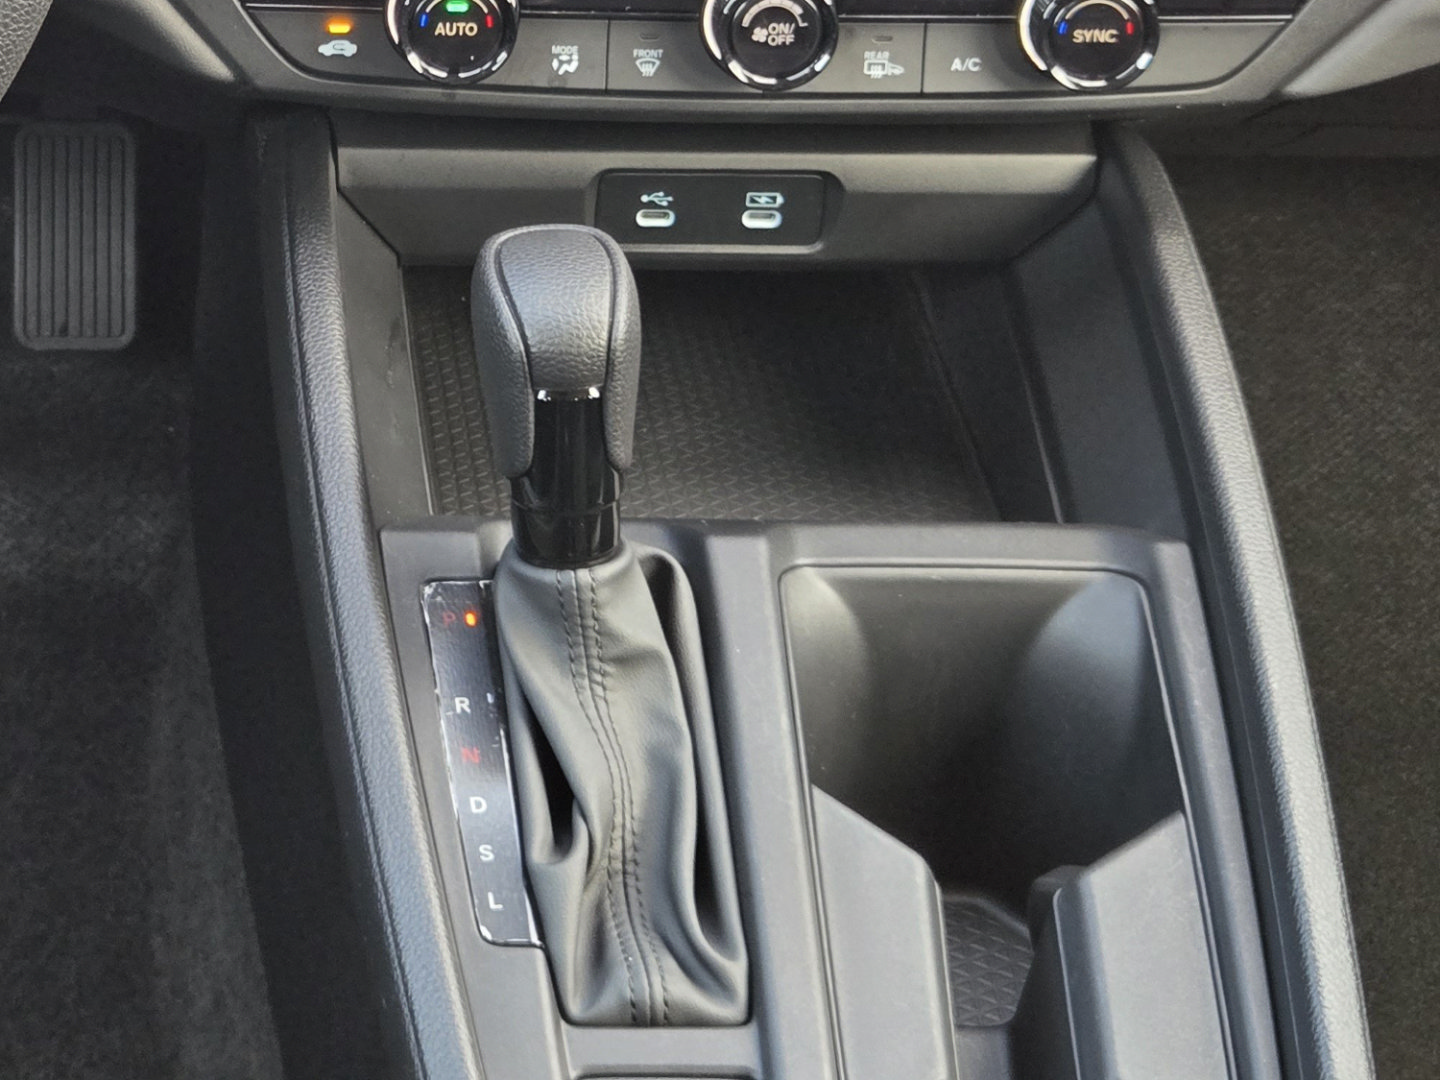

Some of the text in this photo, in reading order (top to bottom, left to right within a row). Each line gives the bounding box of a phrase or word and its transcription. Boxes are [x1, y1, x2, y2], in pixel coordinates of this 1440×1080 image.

[434, 22, 478, 38] AUTO
[768, 22, 795, 35] ON/
[1072, 28, 1117, 44] SYNC
[767, 34, 795, 46] OFF
[551, 45, 578, 55] MODE
[633, 49, 663, 58] FRONT
[864, 51, 889, 61] REAR
[951, 57, 981, 72] A/C
[443, 612, 456, 626] P
[454, 696, 471, 714] R
[462, 746, 481, 764] N
[470, 796, 487, 814] D
[479, 844, 494, 862] S
[488, 892, 503, 911] L
